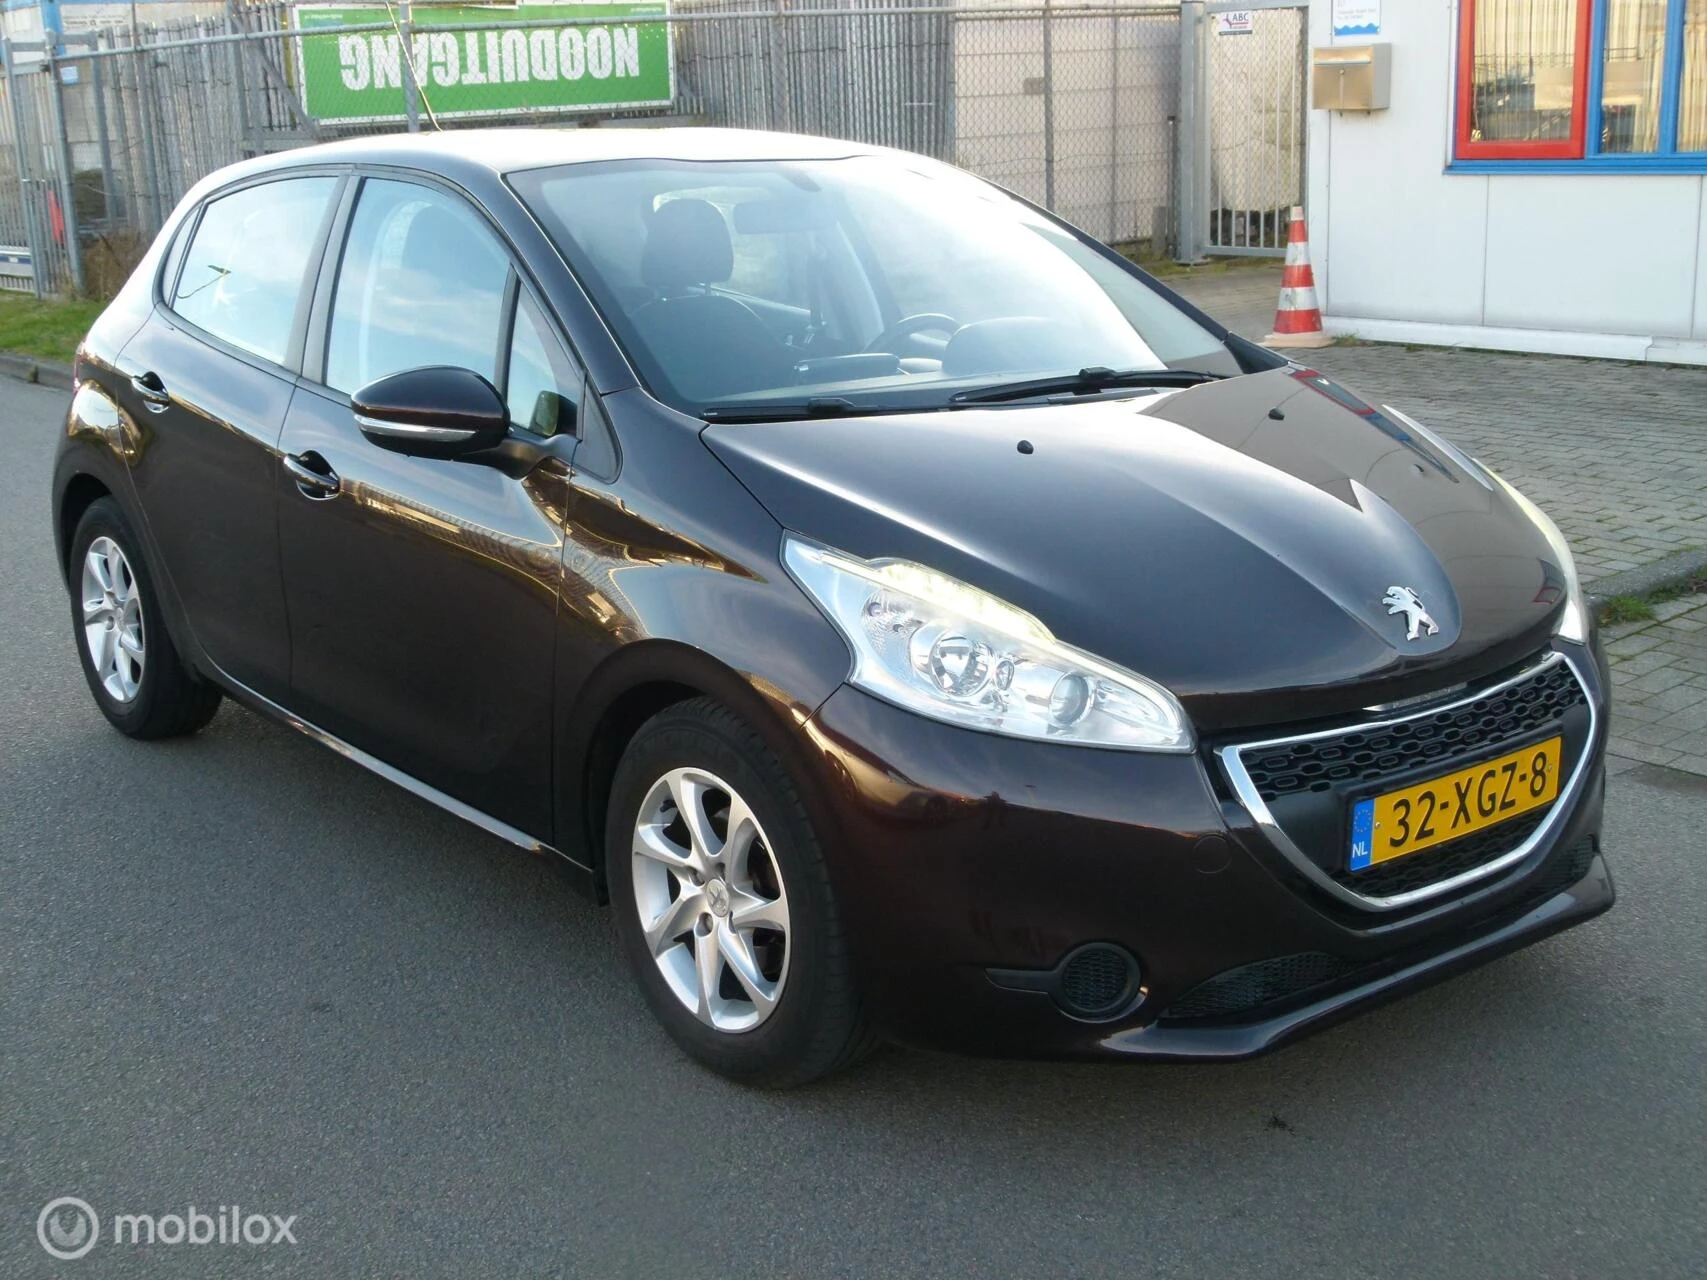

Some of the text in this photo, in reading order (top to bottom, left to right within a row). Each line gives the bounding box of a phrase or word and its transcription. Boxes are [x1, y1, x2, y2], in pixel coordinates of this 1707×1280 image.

[1232, 12, 1249, 21] ABC
[1389, 751, 1547, 847] 32-XGZ-8
[1352, 841, 1368, 858] NL
